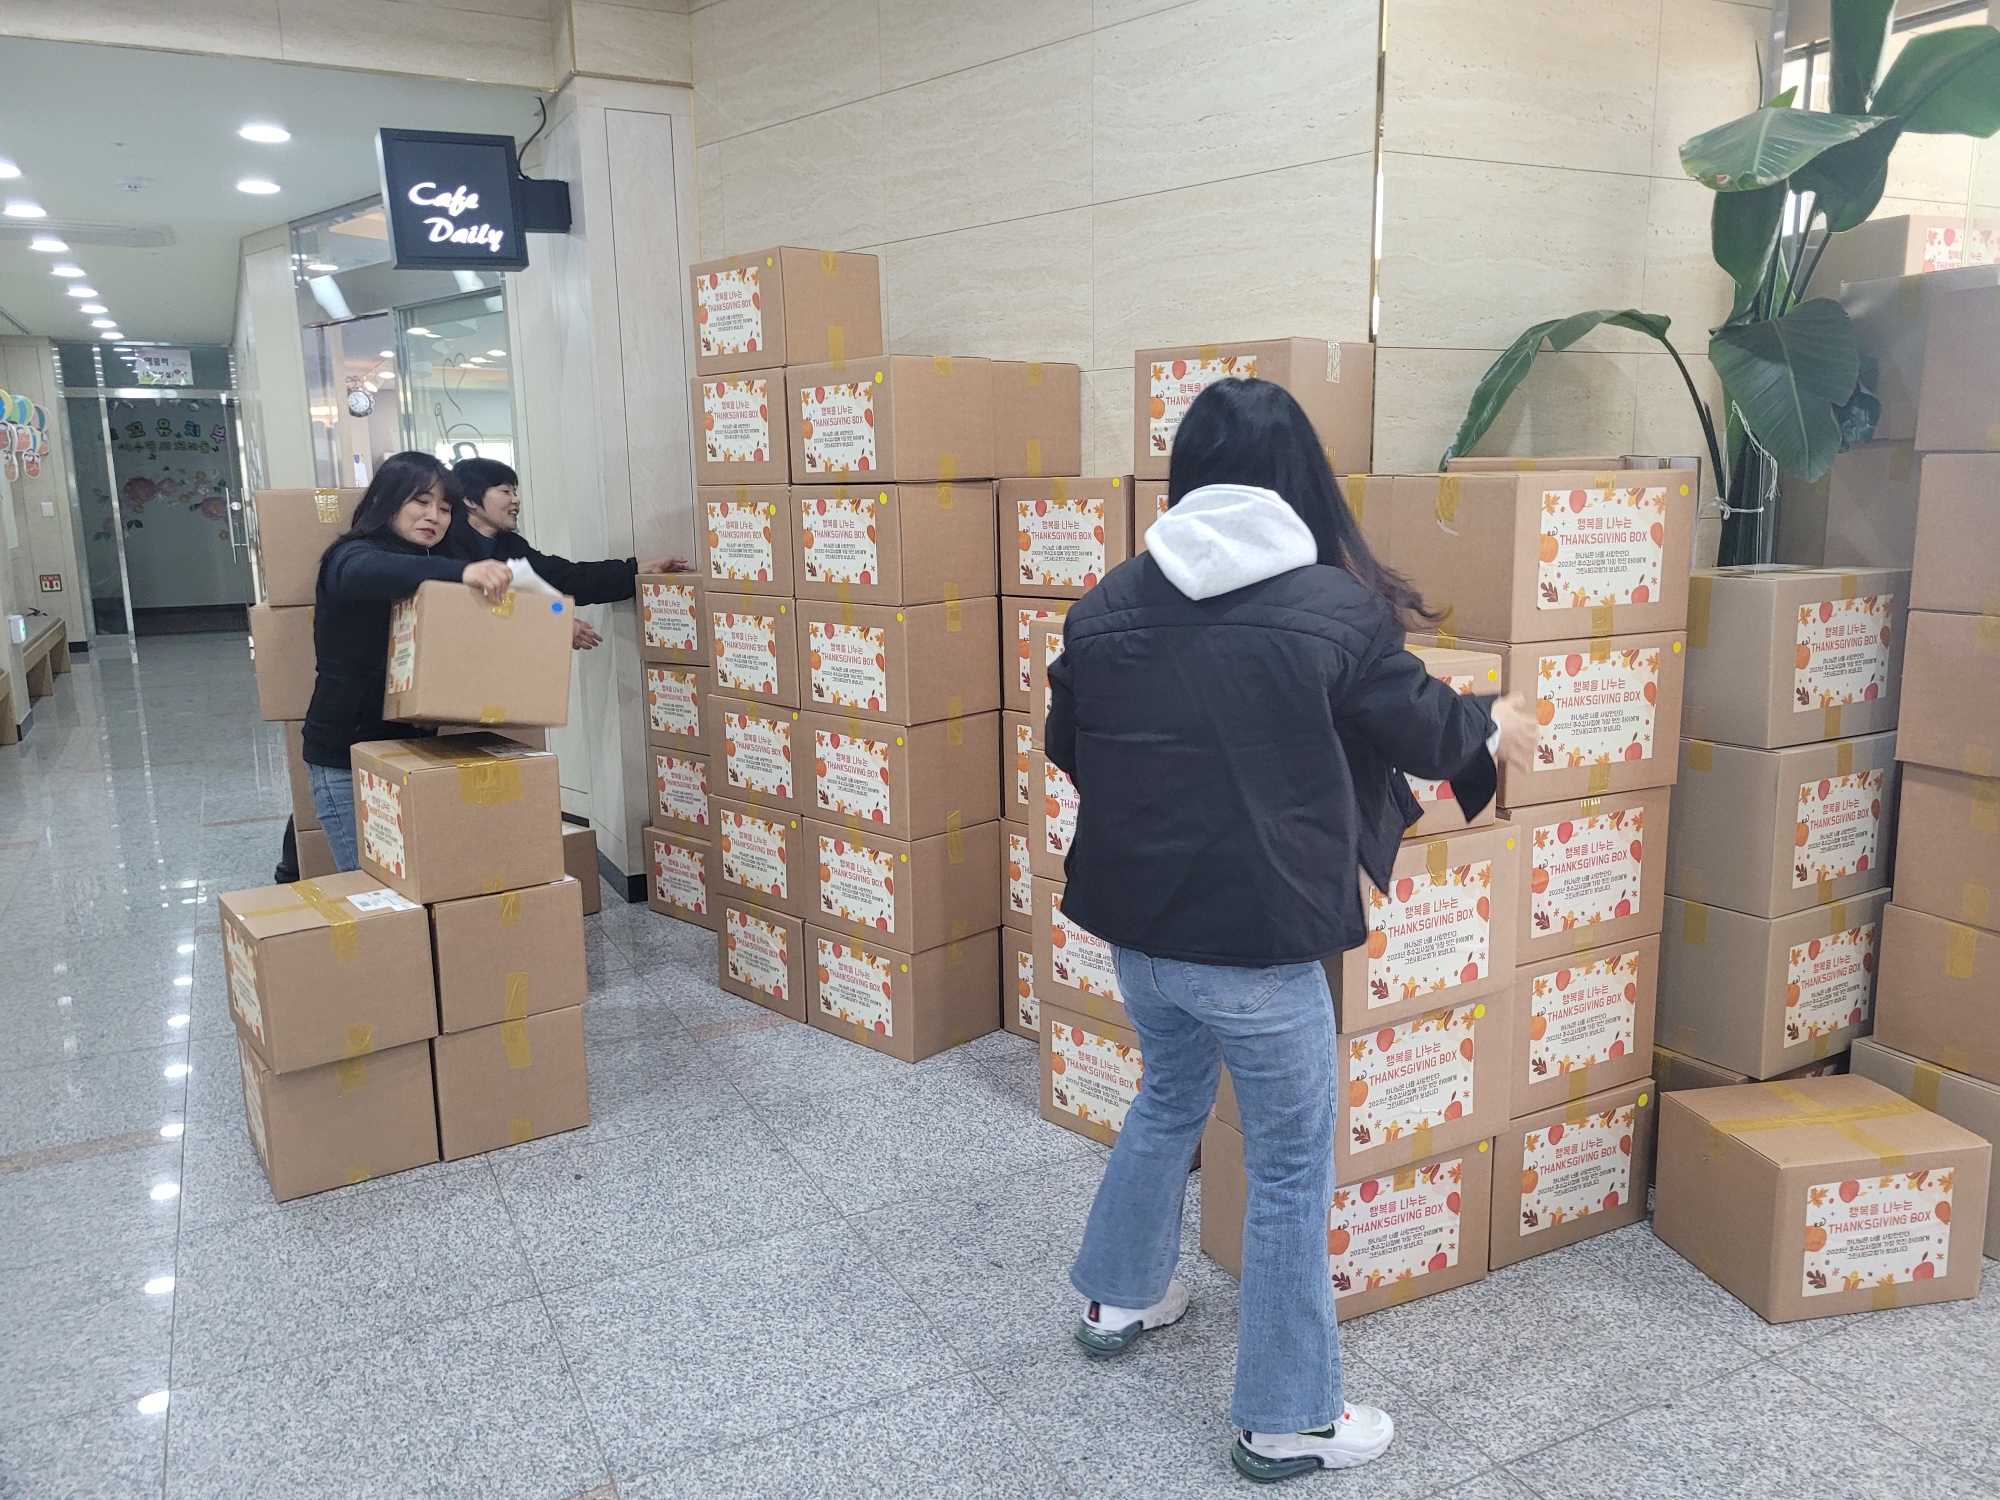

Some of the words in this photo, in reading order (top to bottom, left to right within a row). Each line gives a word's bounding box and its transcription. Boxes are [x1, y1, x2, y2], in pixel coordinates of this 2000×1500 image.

[408, 182, 479, 217] Cafe
[422, 217, 504, 252] Daily
[714, 291, 728, 302] 행복을
[728, 289, 742, 300] 나누는
[707, 300, 741, 313] THANKSGIVING
[741, 298, 751, 308] BOX
[713, 410, 748, 420] THANKSGIVING
[748, 410, 759, 418] BOX
[821, 405, 836, 416] 행복을
[837, 404, 853, 415] 나누는
[812, 416, 851, 427] THANKSGIVING
[851, 414, 863, 424] BOX
[822, 519, 838, 528] 행복을
[839, 519, 855, 528] 나누는
[1041, 520, 1060, 530] 행복을
[1061, 520, 1080, 529] 나누는
[1577, 517, 1604, 531] 행복을
[1606, 516, 1632, 529] 나누는
[718, 530, 751, 539] THANKSGIVING
[752, 531, 762, 539] BOX
[813, 530, 853, 538] THANKSGIVING
[853, 530, 866, 539] BOX
[1030, 531, 1077, 540] THANKSGIVING
[1078, 531, 1092, 540] BOX
[1559, 531, 1627, 546] THANKSGIVING
[1629, 530, 1648, 542] BOX
[1824, 624, 1845, 639] 행복을
[1846, 622, 1866, 635] 나누는
[723, 640, 756, 651] THANKSGIVING
[757, 644, 767, 652] BOX
[830, 642, 846, 653] 행복을
[847, 644, 863, 655] 나누는
[1810, 636, 1862, 653] THANKSGIVING
[1863, 634, 1878, 646] BOX
[821, 652, 861, 665] THANKSGIVING
[862, 657, 874, 666] BOX
[1572, 679, 1598, 694] 행복을
[1601, 677, 1626, 691] 나누는
[1555, 692, 1621, 709] THANKSGIVING
[1623, 690, 1641, 702] BOX
[735, 740, 770, 754] THANKSGIVING
[771, 747, 782, 756] BOX
[835, 752, 851, 764] 행복을
[852, 755, 868, 767] 나누는
[826, 760, 866, 776] THANKSGIVING
[867, 769, 879, 779] BOX
[1822, 800, 1841, 815] 행복을
[1841, 796, 1859, 811] 나누는
[1809, 810, 1856, 831] THANKSGIVING
[1856, 807, 1869, 820] BOX
[1565, 843, 1588, 860] 행복을
[1591, 838, 1613, 854] 나누는
[839, 859, 855, 871] 행복을
[856, 863, 872, 876] 나누는
[1549, 853, 1610, 876] THANKSGIVING
[1611, 849, 1628, 862] BOX
[830, 866, 870, 885] THANKSGIVING
[871, 877, 883, 888] BOX
[1405, 901, 1431, 921] 행복을
[1433, 895, 1458, 913] 나누는
[1388, 911, 1454, 939] THANKSGIVING
[1456, 906, 1474, 922] BOX
[838, 961, 853, 975] 행복을
[854, 967, 870, 980] 나누는
[1813, 958, 1832, 975] 행복을
[1833, 952, 1851, 968] 나누는
[829, 968, 868, 988] THANKSGIVING
[869, 981, 881, 993] BOX
[1801, 966, 1847, 990] THANKSGIVING
[1848, 961, 1861, 975] BOX
[1562, 989, 1585, 1006] 행복을
[1587, 982, 1609, 999] 나누는
[1547, 996, 1605, 1023] THANKSGIVING
[1606, 992, 1622, 1006] BOX
[1078, 1050, 1098, 1067] 행복을
[1100, 1058, 1120, 1074] 나누는
[1386, 1048, 1412, 1068] 행복을
[1415, 1039, 1441, 1059] 나누는
[1066, 1057, 1117, 1084] THANKSGIVING
[1118, 1076, 1133, 1090] BOX
[1369, 1055, 1437, 1087] THANKSGIVING
[1439, 1049, 1457, 1065] BOX
[1555, 1142, 1578, 1160] 행복을
[1580, 1135, 1603, 1152] 나누는
[1539, 1149, 1599, 1177] THANKSGIVING
[1601, 1144, 1617, 1158] BOX
[1369, 1200, 1397, 1219] 행복을
[1400, 1192, 1427, 1210] 나누는
[1848, 1203, 1879, 1219] 행복을
[1882, 1198, 1913, 1214] 나누는
[1350, 1207, 1422, 1237] THANKSGIVING
[1424, 1202, 1444, 1217] BOX
[1827, 1213, 1907, 1235] THANKSGIVING
[1910, 1210, 1932, 1223] BOX
